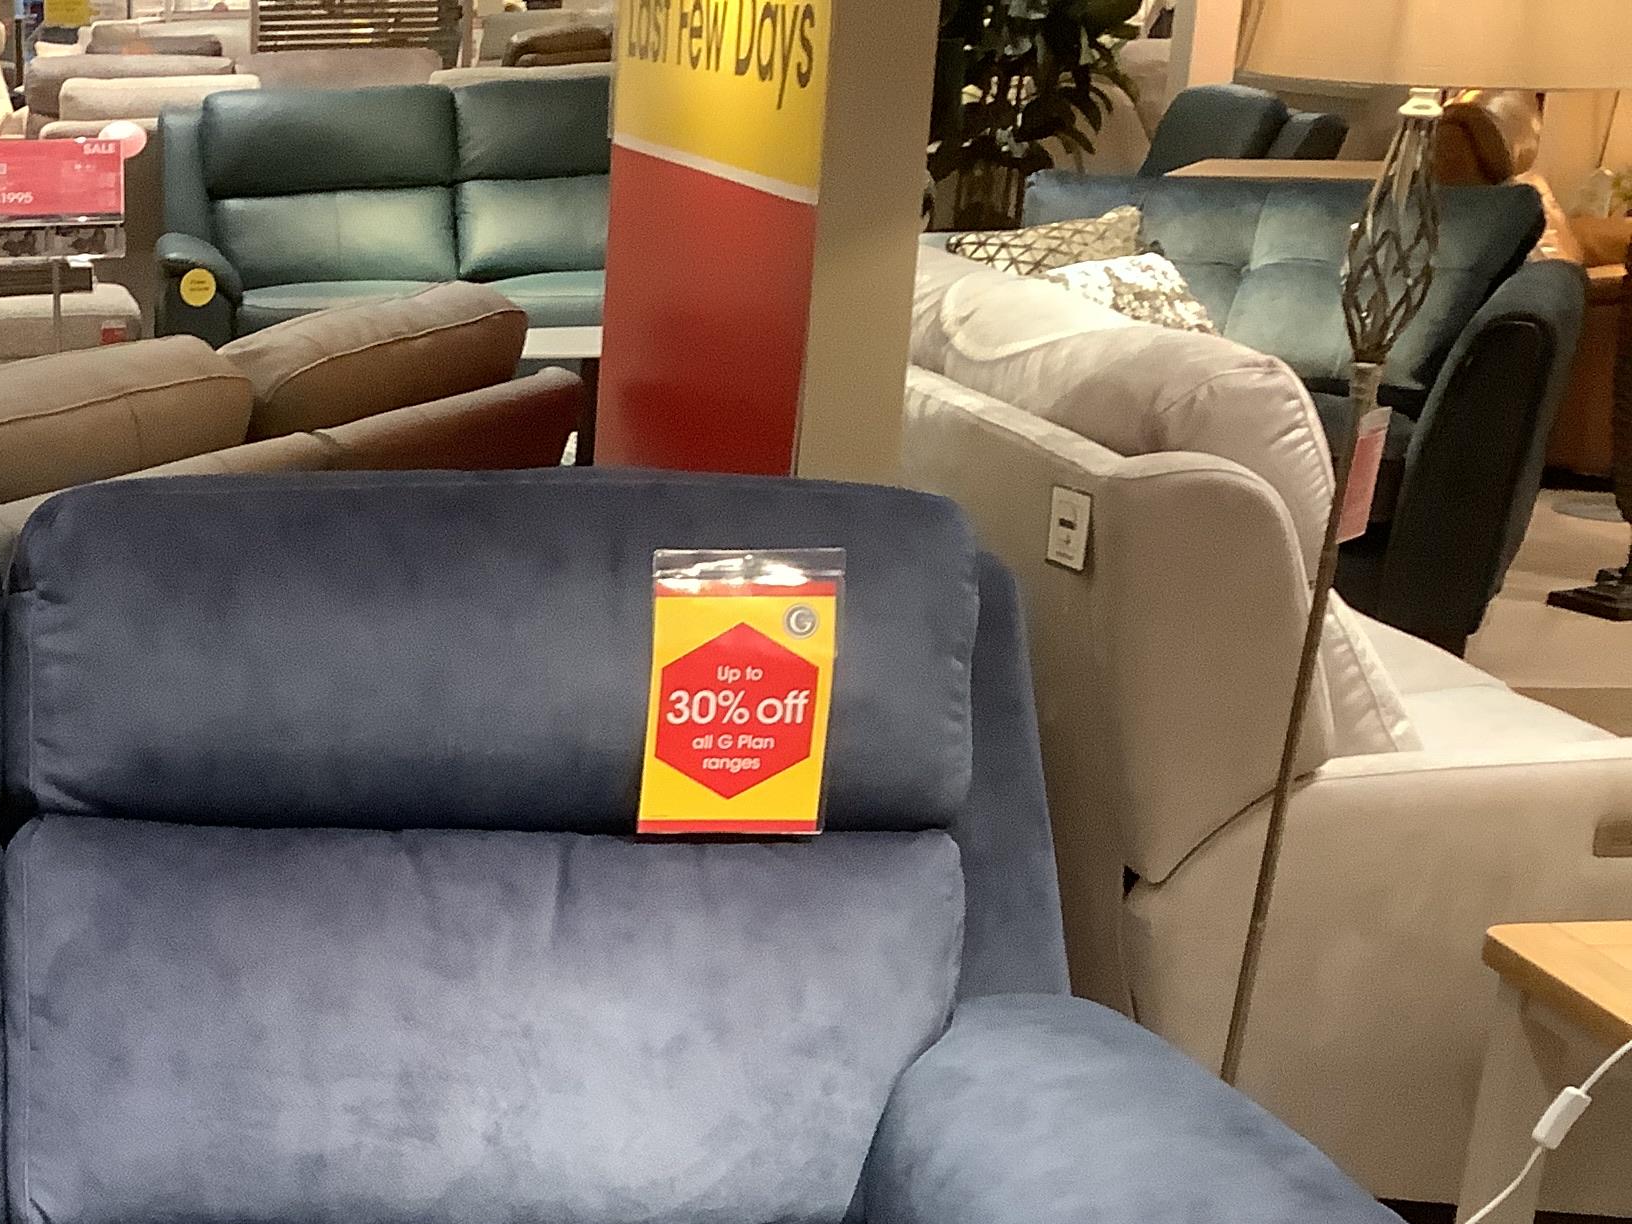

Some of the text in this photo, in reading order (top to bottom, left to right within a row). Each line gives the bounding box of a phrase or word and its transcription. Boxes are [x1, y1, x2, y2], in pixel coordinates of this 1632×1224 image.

[628, 0, 816, 110] Last Few Days
[83, 143, 116, 155] SALE
[717, 665, 763, 683] Up to
[666, 689, 811, 725] 30% off
[692, 733, 775, 750] all G Plan
[702, 756, 760, 773] ranges
